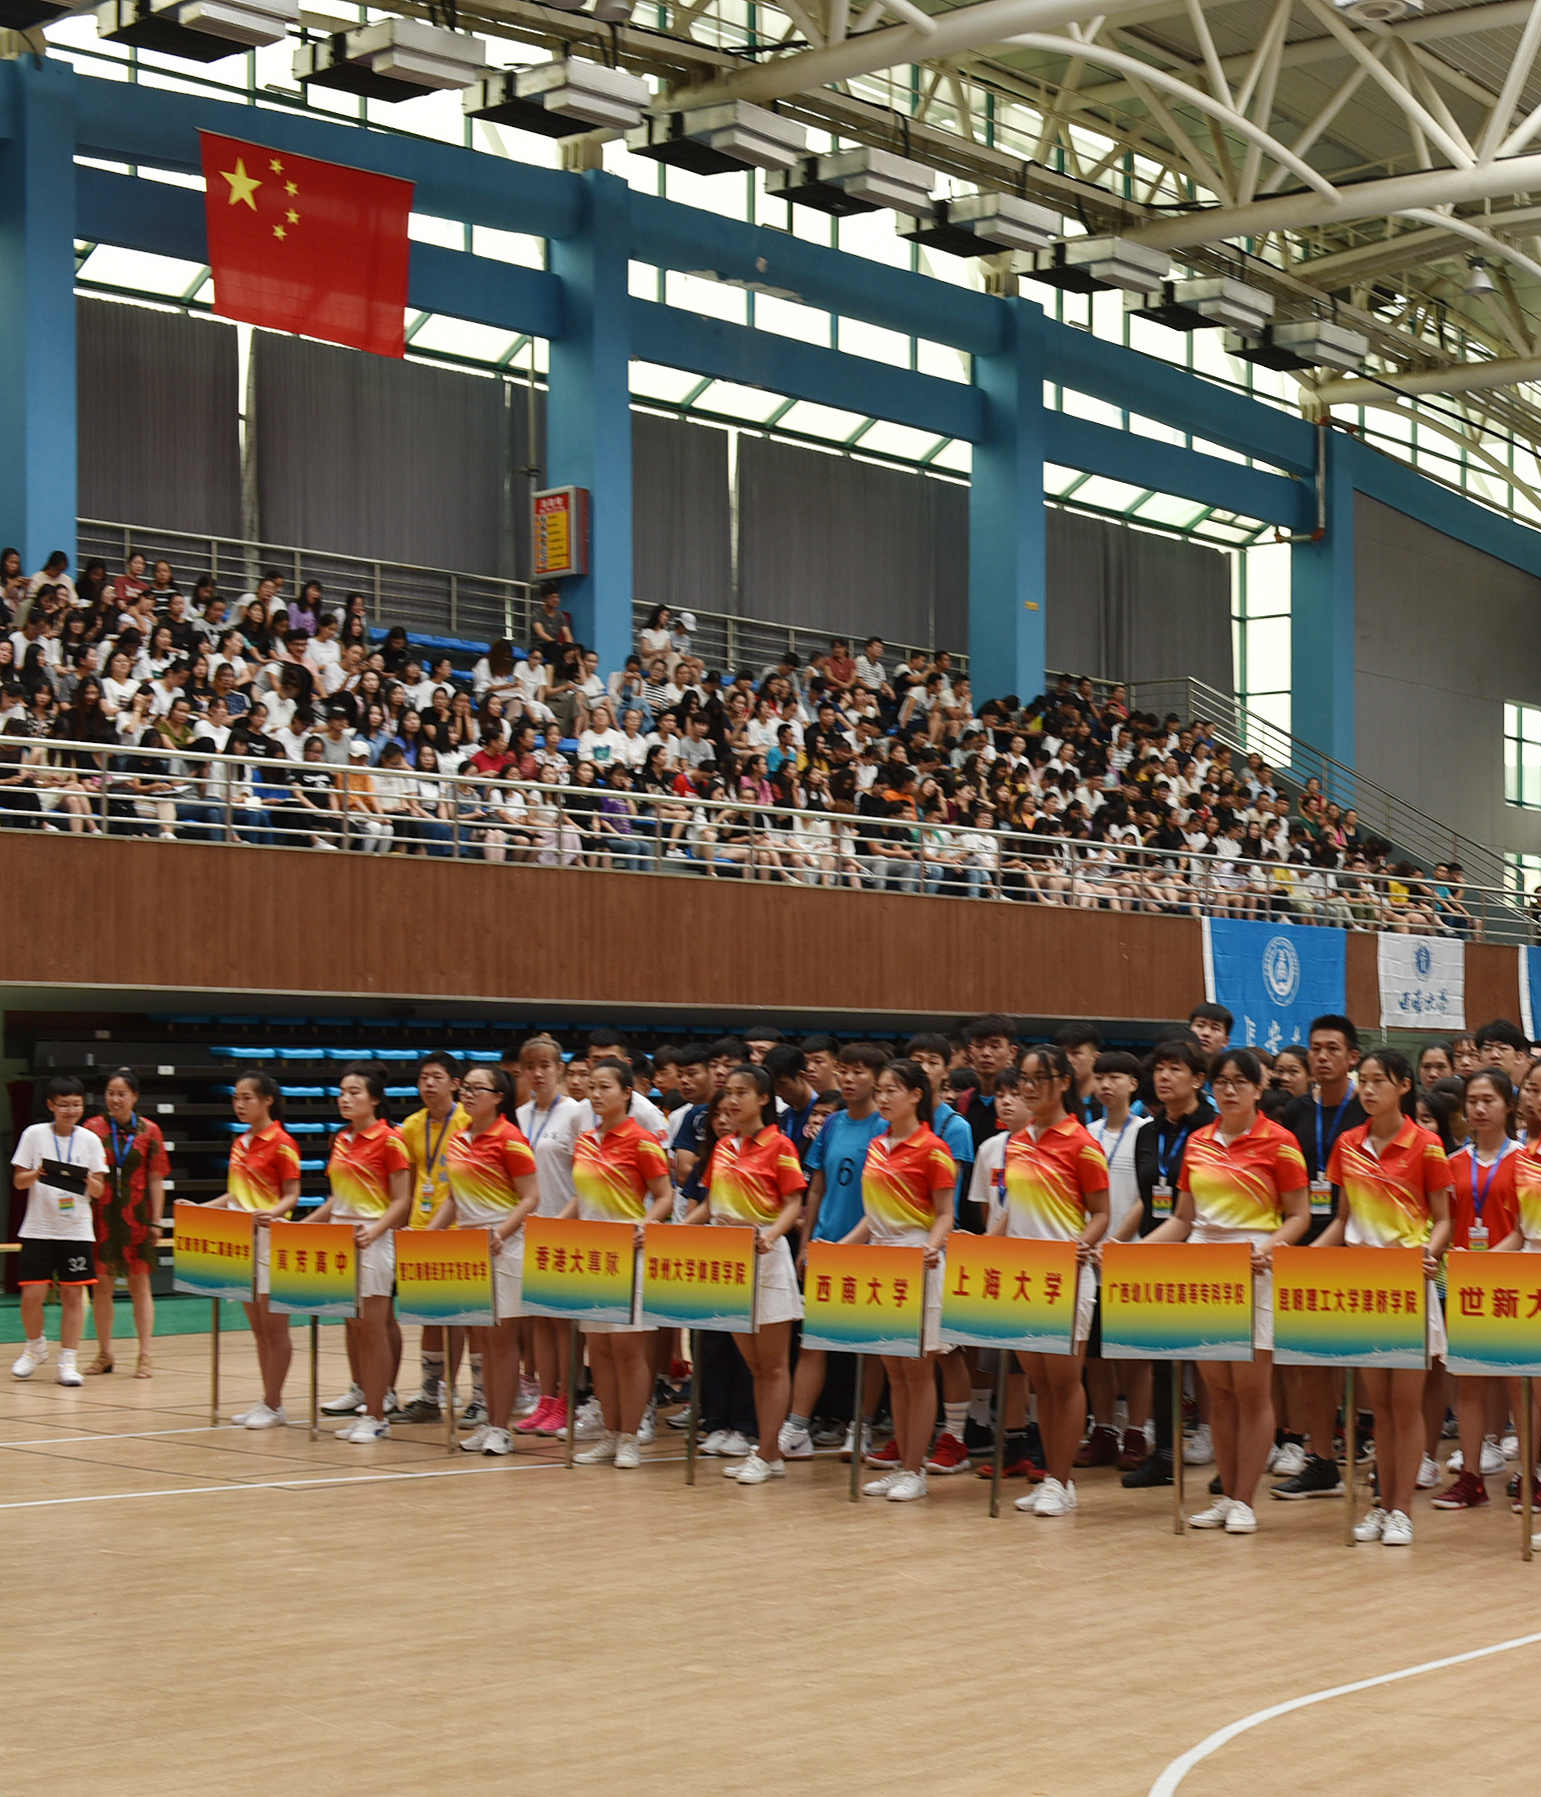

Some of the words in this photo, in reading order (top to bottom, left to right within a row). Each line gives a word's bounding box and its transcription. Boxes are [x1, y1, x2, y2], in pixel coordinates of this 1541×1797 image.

[837, 1157, 856, 1187] 6
[68, 1256, 89, 1273] 32
[815, 1274, 908, 1309] 西南大学
[951, 1265, 1063, 1305] 上海大学
